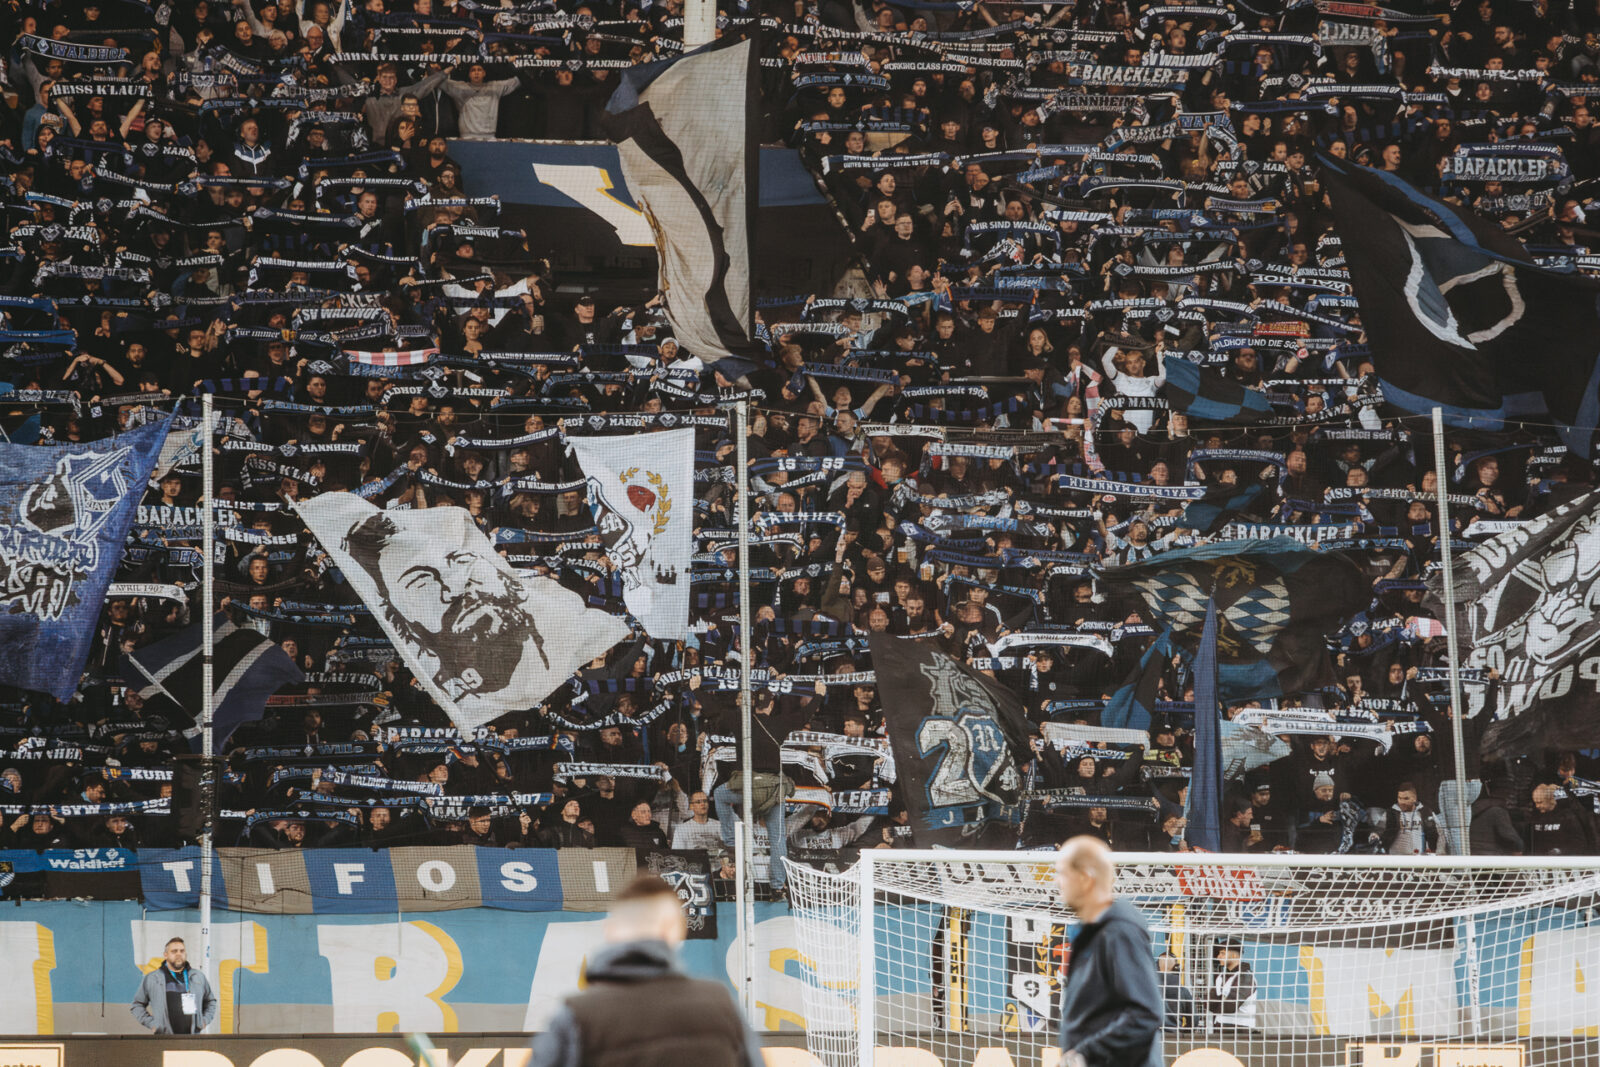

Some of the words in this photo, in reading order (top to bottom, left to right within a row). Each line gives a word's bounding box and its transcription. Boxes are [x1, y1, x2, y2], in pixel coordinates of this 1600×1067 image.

[51, 43, 128, 60] WALDHOF
[512, 59, 562, 69] WALDHOF
[1142, 53, 1159, 66] SV
[1160, 52, 1218, 66] WALDHOF
[917, 63, 942, 71] CLASS
[1082, 64, 1172, 83] BARACKLER
[1454, 157, 1548, 177] BARACKLER
[331, 178, 363, 186] WALDHOF
[363, 178, 401, 186] MANNHEIM
[970, 223, 988, 232] WIR
[989, 222, 1011, 231] SIND
[1012, 222, 1055, 234] WALDHOF
[295, 260, 335, 269] MANNHEIM
[1132, 265, 1168, 275] WORKING
[1169, 265, 1195, 274] CLASS
[1195, 260, 1234, 272] FOOTBALL
[1318, 268, 1342, 279] CLASS
[1319, 298, 1338, 308] WIR
[301, 309, 319, 321] SV
[319, 308, 382, 321] WALDHOF
[1247, 338, 1266, 348] UND
[1267, 339, 1283, 349] DIE
[490, 353, 523, 361] WALDHOF
[523, 353, 561, 362] MANNHEIM
[803, 361, 894, 380] MANNHEIM
[901, 387, 943, 400] Tradition
[946, 386, 965, 397] seit
[513, 431, 547, 444] MANNHEIM
[300, 443, 361, 454] MANNHEIM
[1069, 476, 1130, 494] MANNHEIM
[1133, 485, 1189, 499] WALDHOF
[137, 504, 239, 527] BARACKER
[224, 527, 298, 545] HEIMSIEG
[1237, 525, 1339, 547] BARACKLER
[114, 583, 142, 592] APRIL
[142, 583, 165, 593] 1907
[387, 726, 490, 744] BARACKER
[333, 771, 346, 784] SV
[349, 775, 388, 789] WALDHOF
[391, 780, 443, 796] MANNHEIM
[61, 804, 101, 816] SVW
[73, 848, 100, 859] SV
[48, 857, 126, 871] Waldhof
[163, 861, 610, 895] TIFOSI
